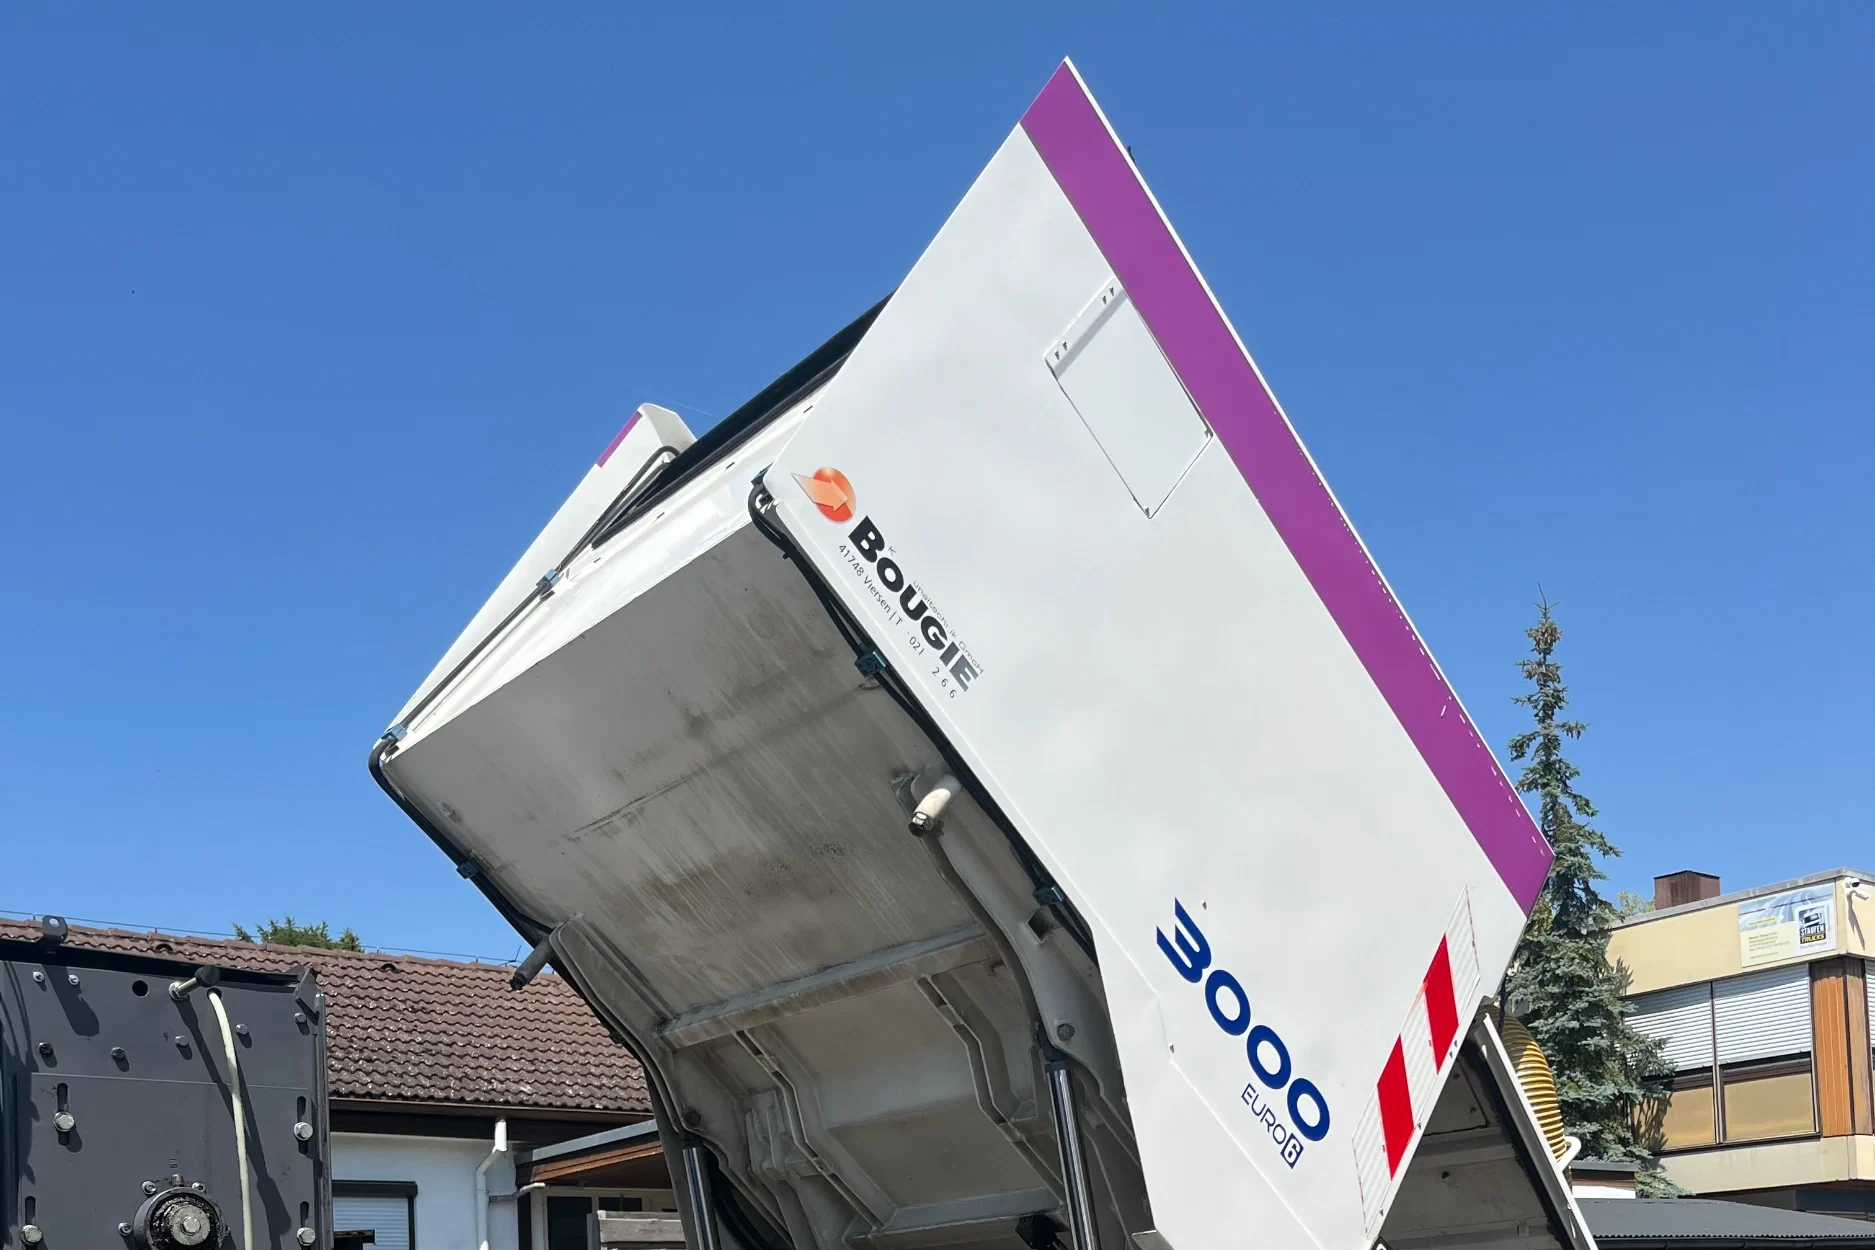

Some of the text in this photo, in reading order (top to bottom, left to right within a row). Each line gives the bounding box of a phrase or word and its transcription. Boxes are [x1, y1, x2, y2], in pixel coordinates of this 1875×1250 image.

[839, 545, 865, 577] 41748
[864, 574, 891, 614] Viersen
[848, 515, 979, 692] BOUGIE
[1800, 924, 1825, 936] STAUFEN
[1801, 933, 1825, 943] TRUCKS
[1156, 897, 1331, 1142] 3000
[1241, 1083, 1304, 1169] EURO6
